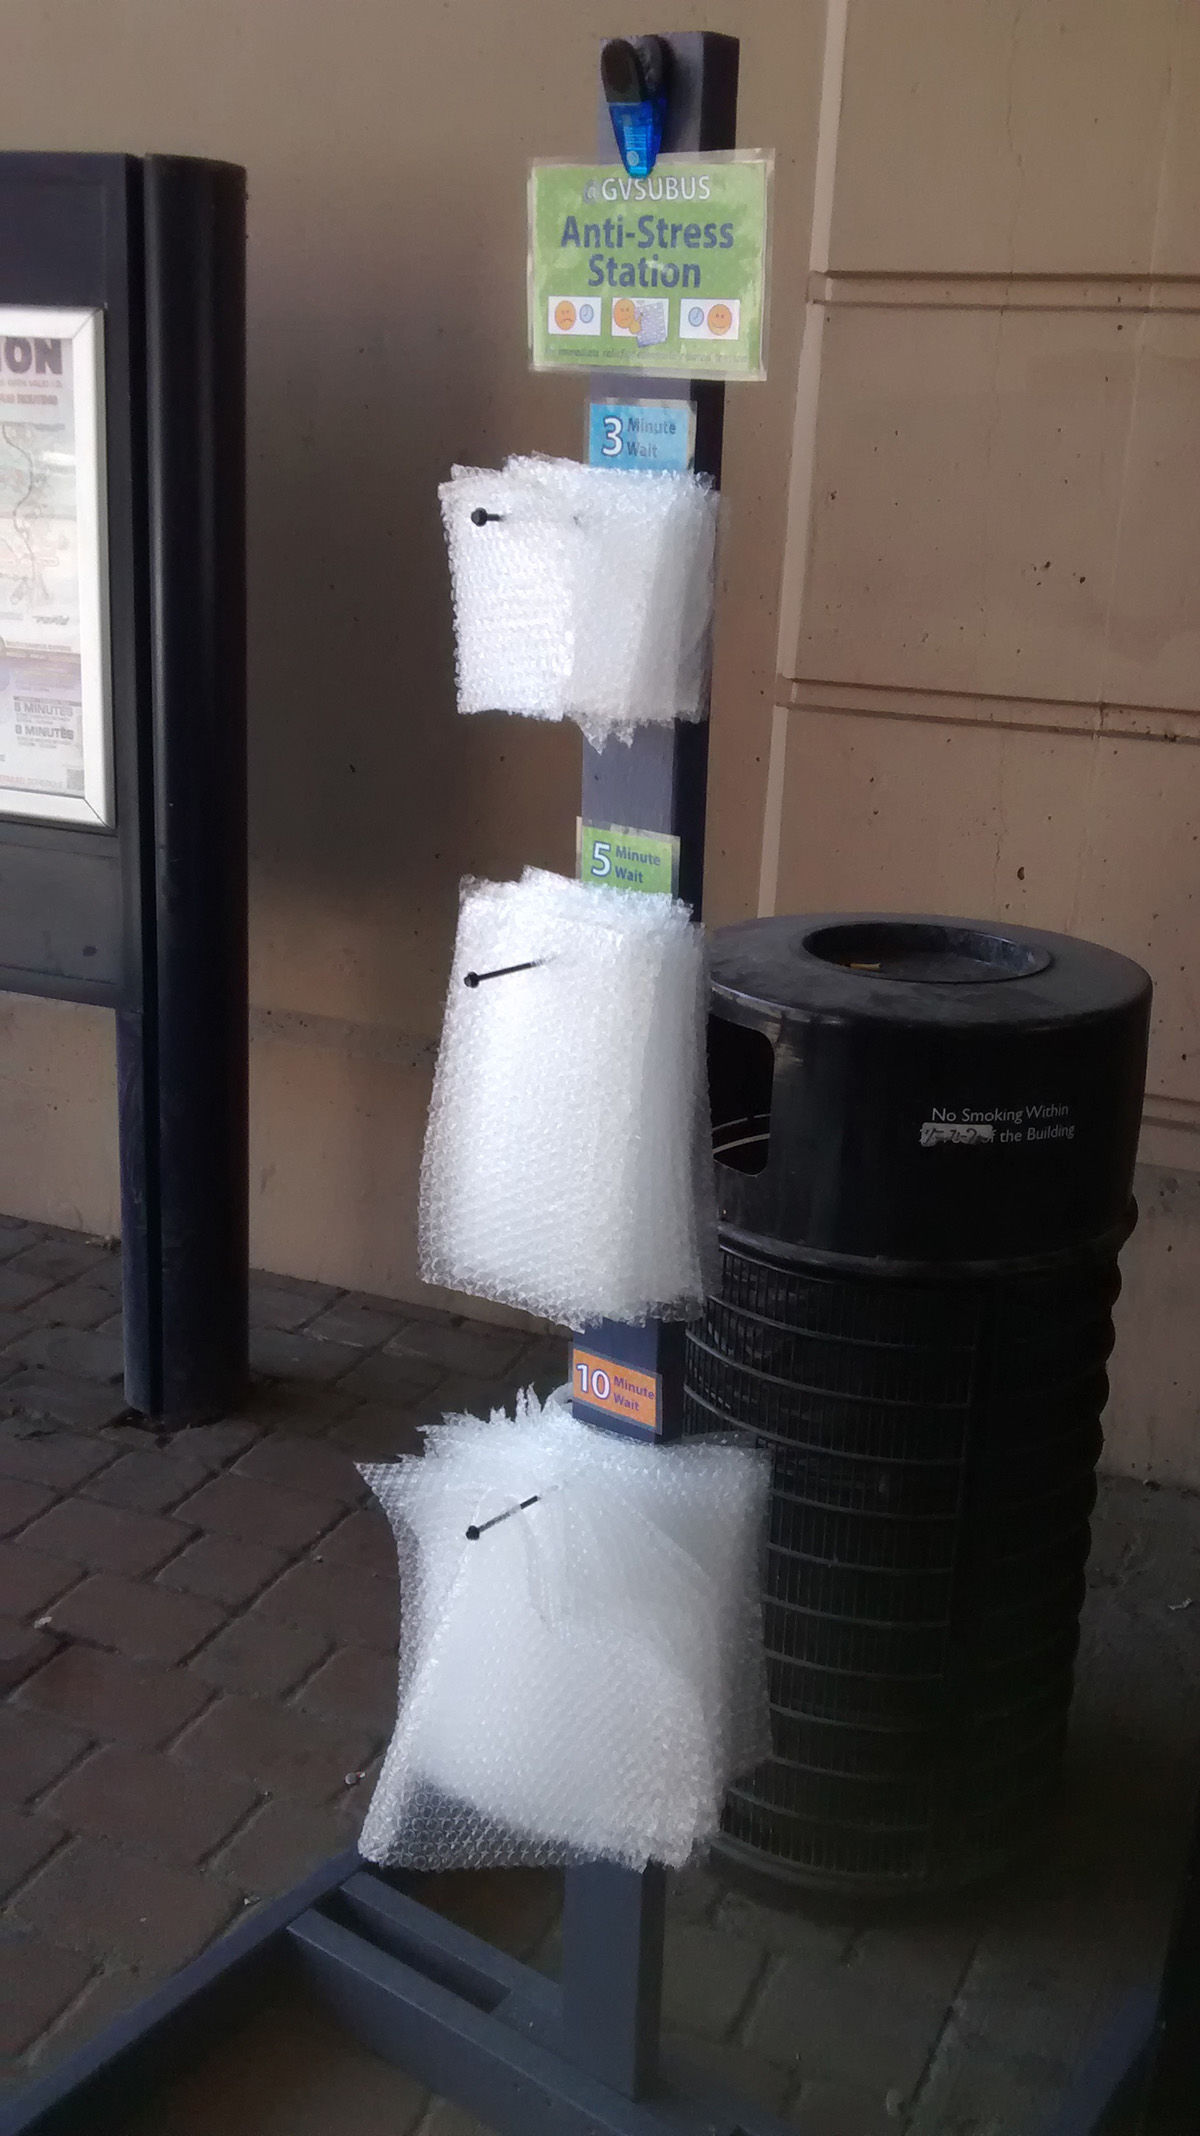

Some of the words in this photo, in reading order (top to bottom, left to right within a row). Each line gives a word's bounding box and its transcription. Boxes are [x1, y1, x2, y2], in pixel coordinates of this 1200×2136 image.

[583, 175, 711, 204] @GVSUBUS
[560, 214, 734, 249] Anti-Stress
[587, 253, 701, 288] Station
[0, 337, 63, 375] ON
[602, 415, 624, 457] 3
[627, 418, 677, 434] Minute
[627, 441, 658, 458] Wait
[591, 841, 612, 877] 5
[616, 846, 661, 866] Minute
[615, 866, 644, 883] Wait
[932, 1107, 957, 1122] No
[961, 1107, 1024, 1124] Smoking
[1025, 1103, 1070, 1119] Within
[1000, 1130, 1022, 1142] the
[1027, 1124, 1076, 1140] Building
[576, 1363, 611, 1399] 10
[613, 1375, 655, 1400] Minute
[613, 1392, 640, 1411] Wait
